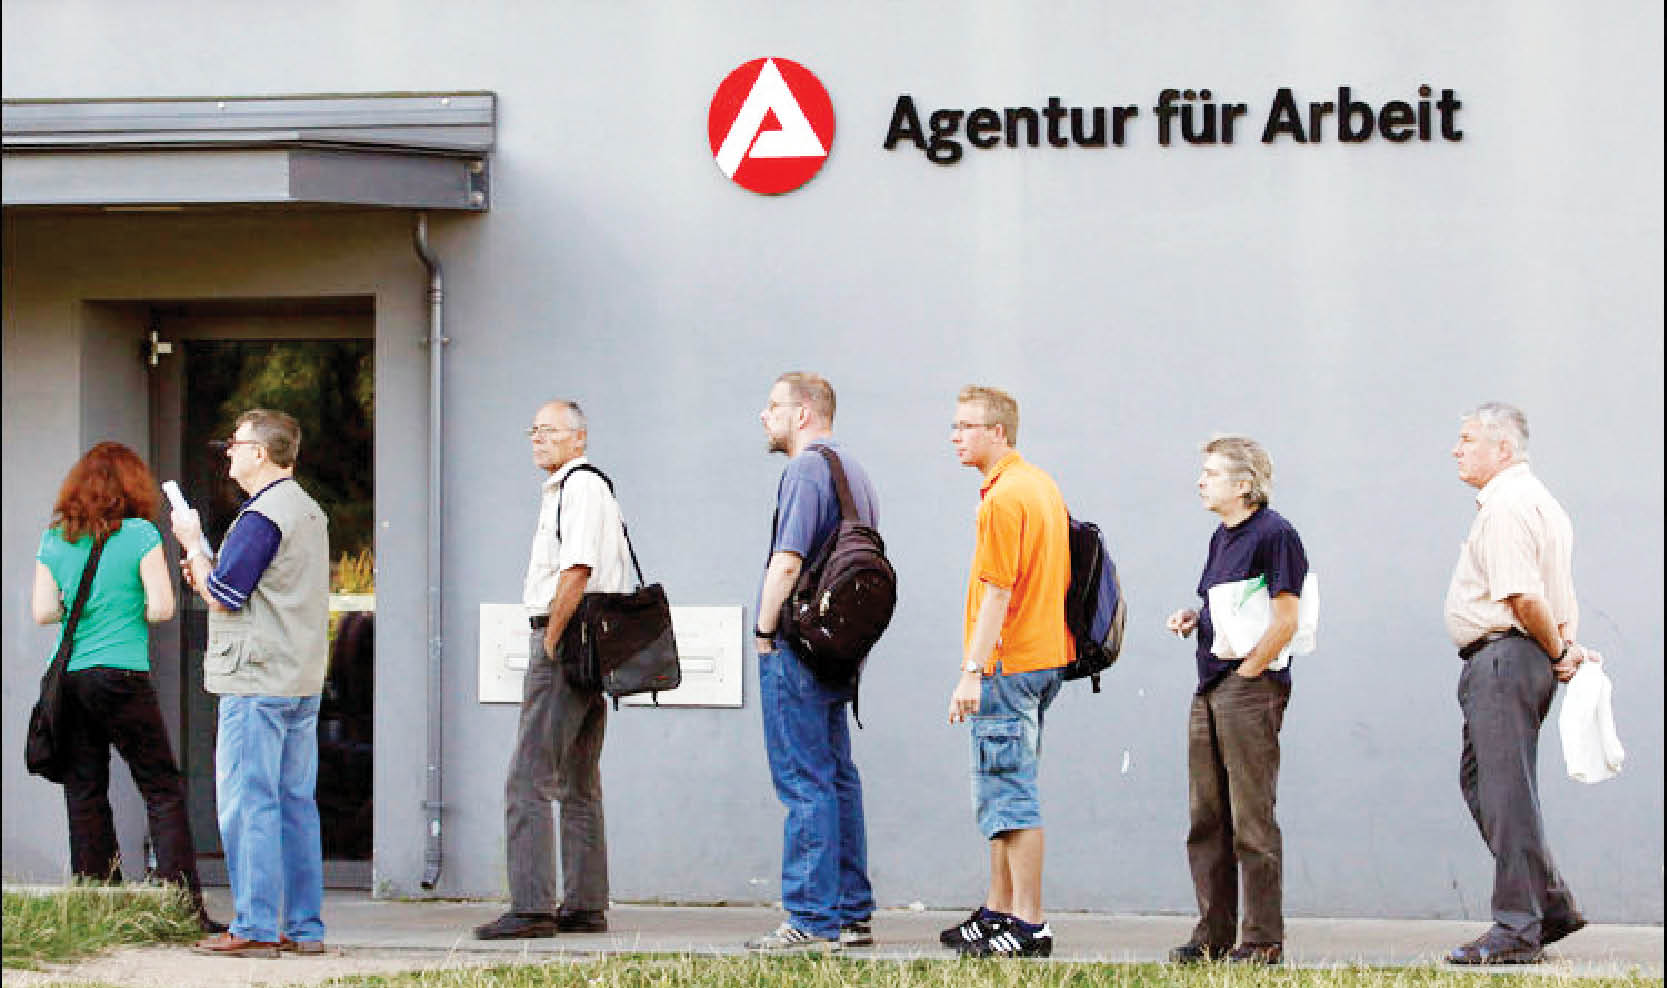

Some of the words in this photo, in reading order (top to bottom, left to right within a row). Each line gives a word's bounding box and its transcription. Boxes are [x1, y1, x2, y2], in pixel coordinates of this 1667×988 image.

[884, 95, 1139, 164] Agentur
[1153, 88, 1248, 148] für
[1261, 83, 1464, 144] Arbeit
